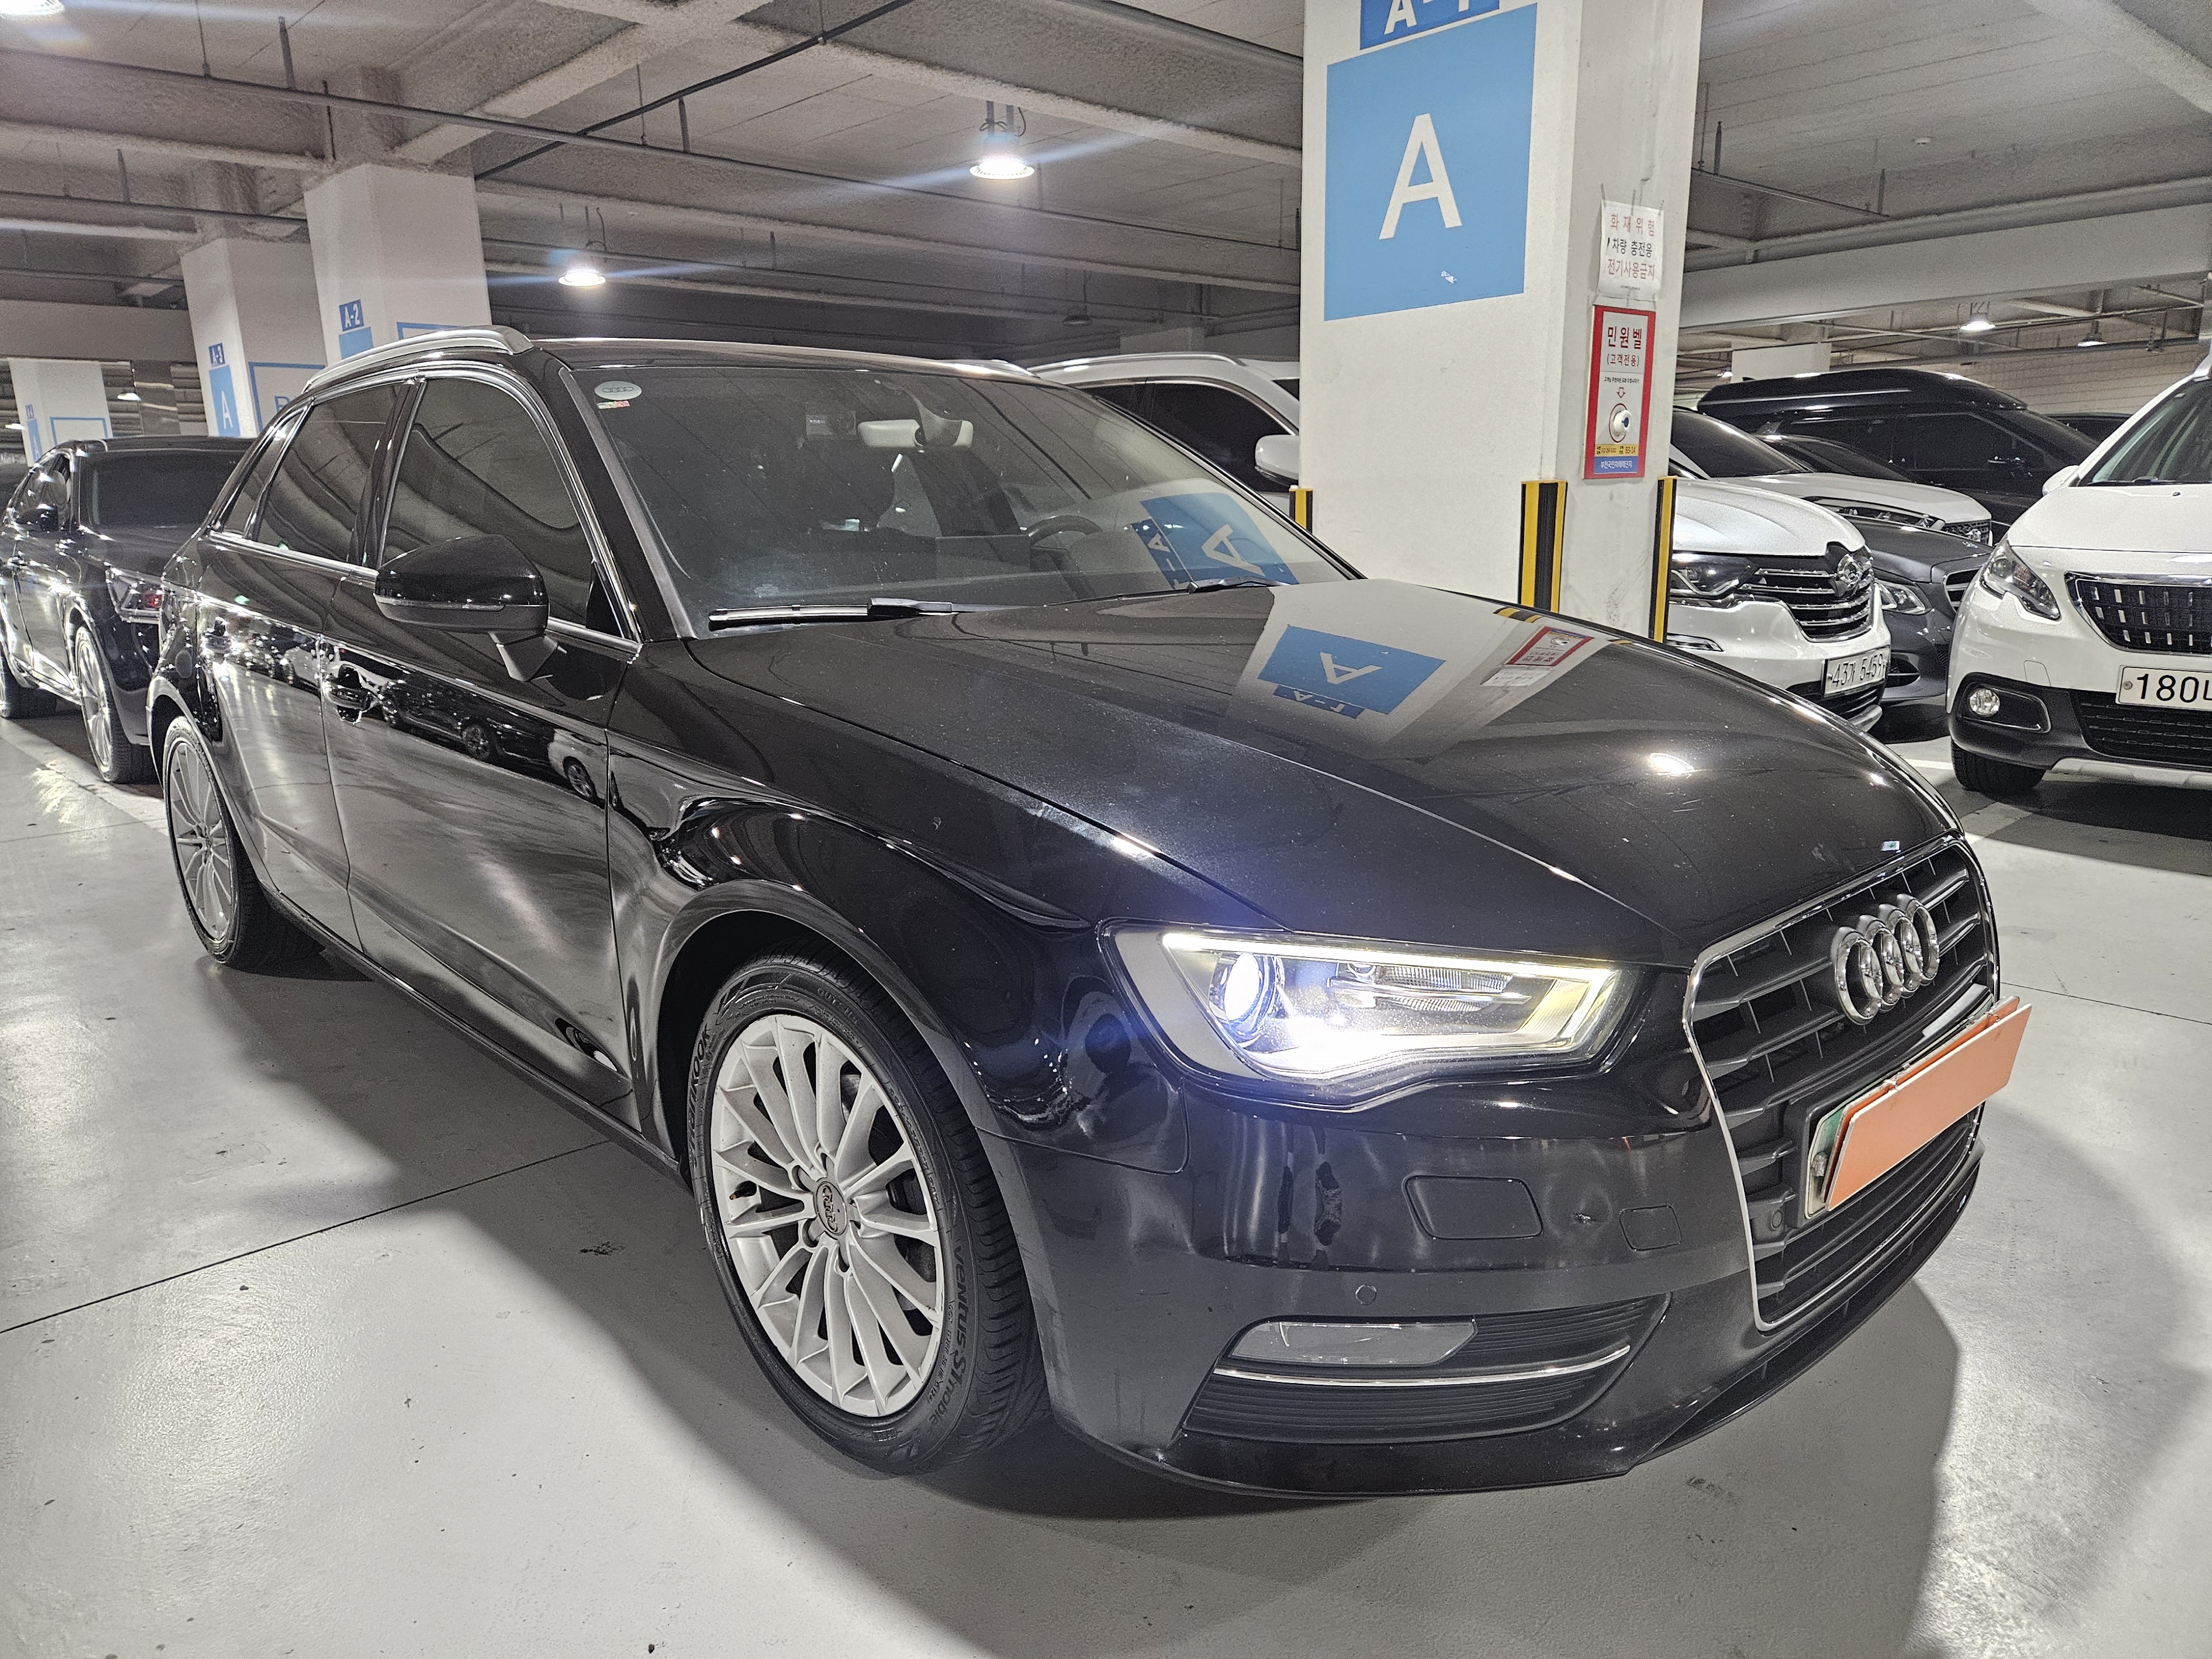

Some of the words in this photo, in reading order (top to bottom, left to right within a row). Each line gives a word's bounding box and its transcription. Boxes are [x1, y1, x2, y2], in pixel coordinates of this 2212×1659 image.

[1379, 113, 1462, 240] A
[1612, 237, 1627, 254] 차량
[1631, 240, 1653, 258] 충전용
[1608, 258, 1655, 281] 전기사용금지
[344, 302, 361, 328] A-2
[1608, 326, 1642, 349] 민원벨
[211, 345, 223, 366] A-3
[1607, 353, 1640, 367] (고객전용)
[221, 390, 234, 430] A
[1860, 653, 1884, 681] 5459
